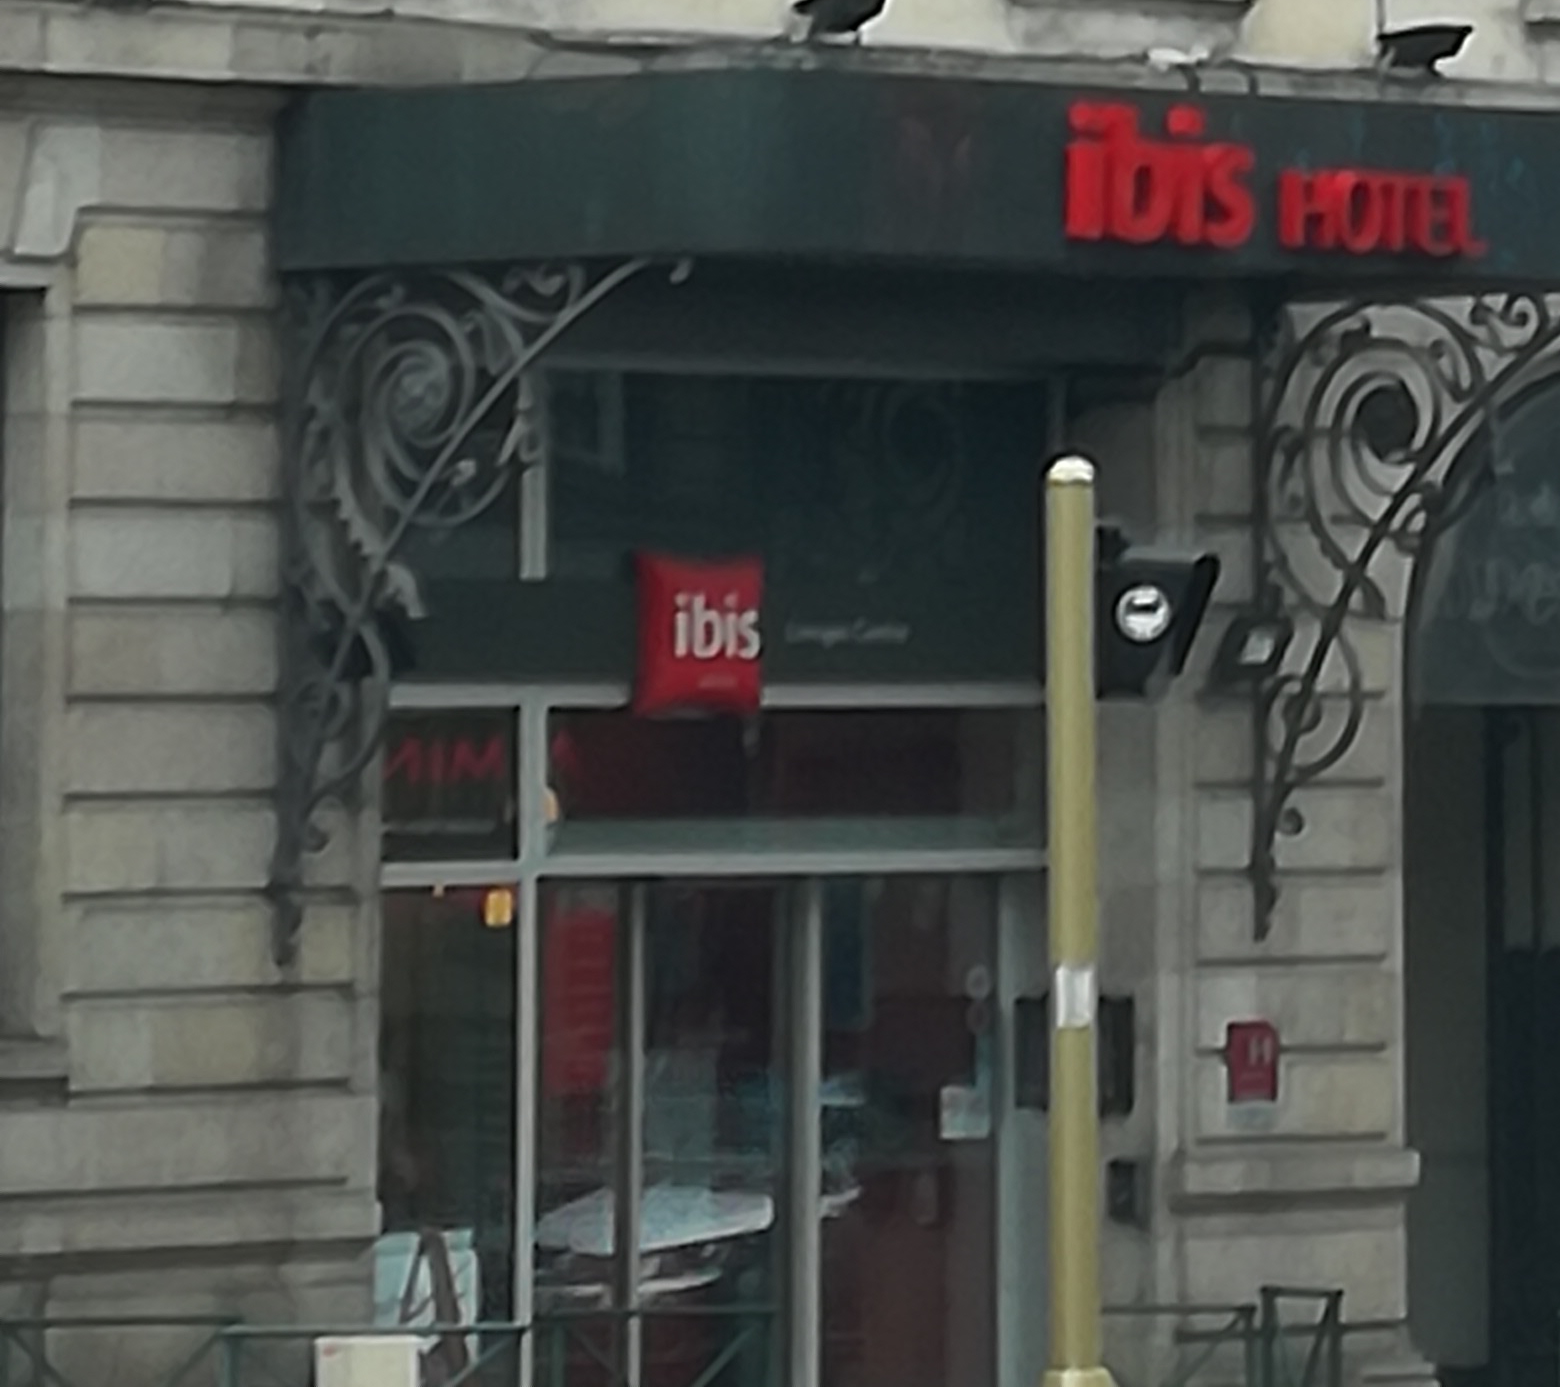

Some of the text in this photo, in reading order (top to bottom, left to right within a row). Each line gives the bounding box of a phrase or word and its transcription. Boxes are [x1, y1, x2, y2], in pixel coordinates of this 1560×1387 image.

[1065, 101, 1487, 257] ibis HOTEL
[674, 590, 761, 660] ibis
